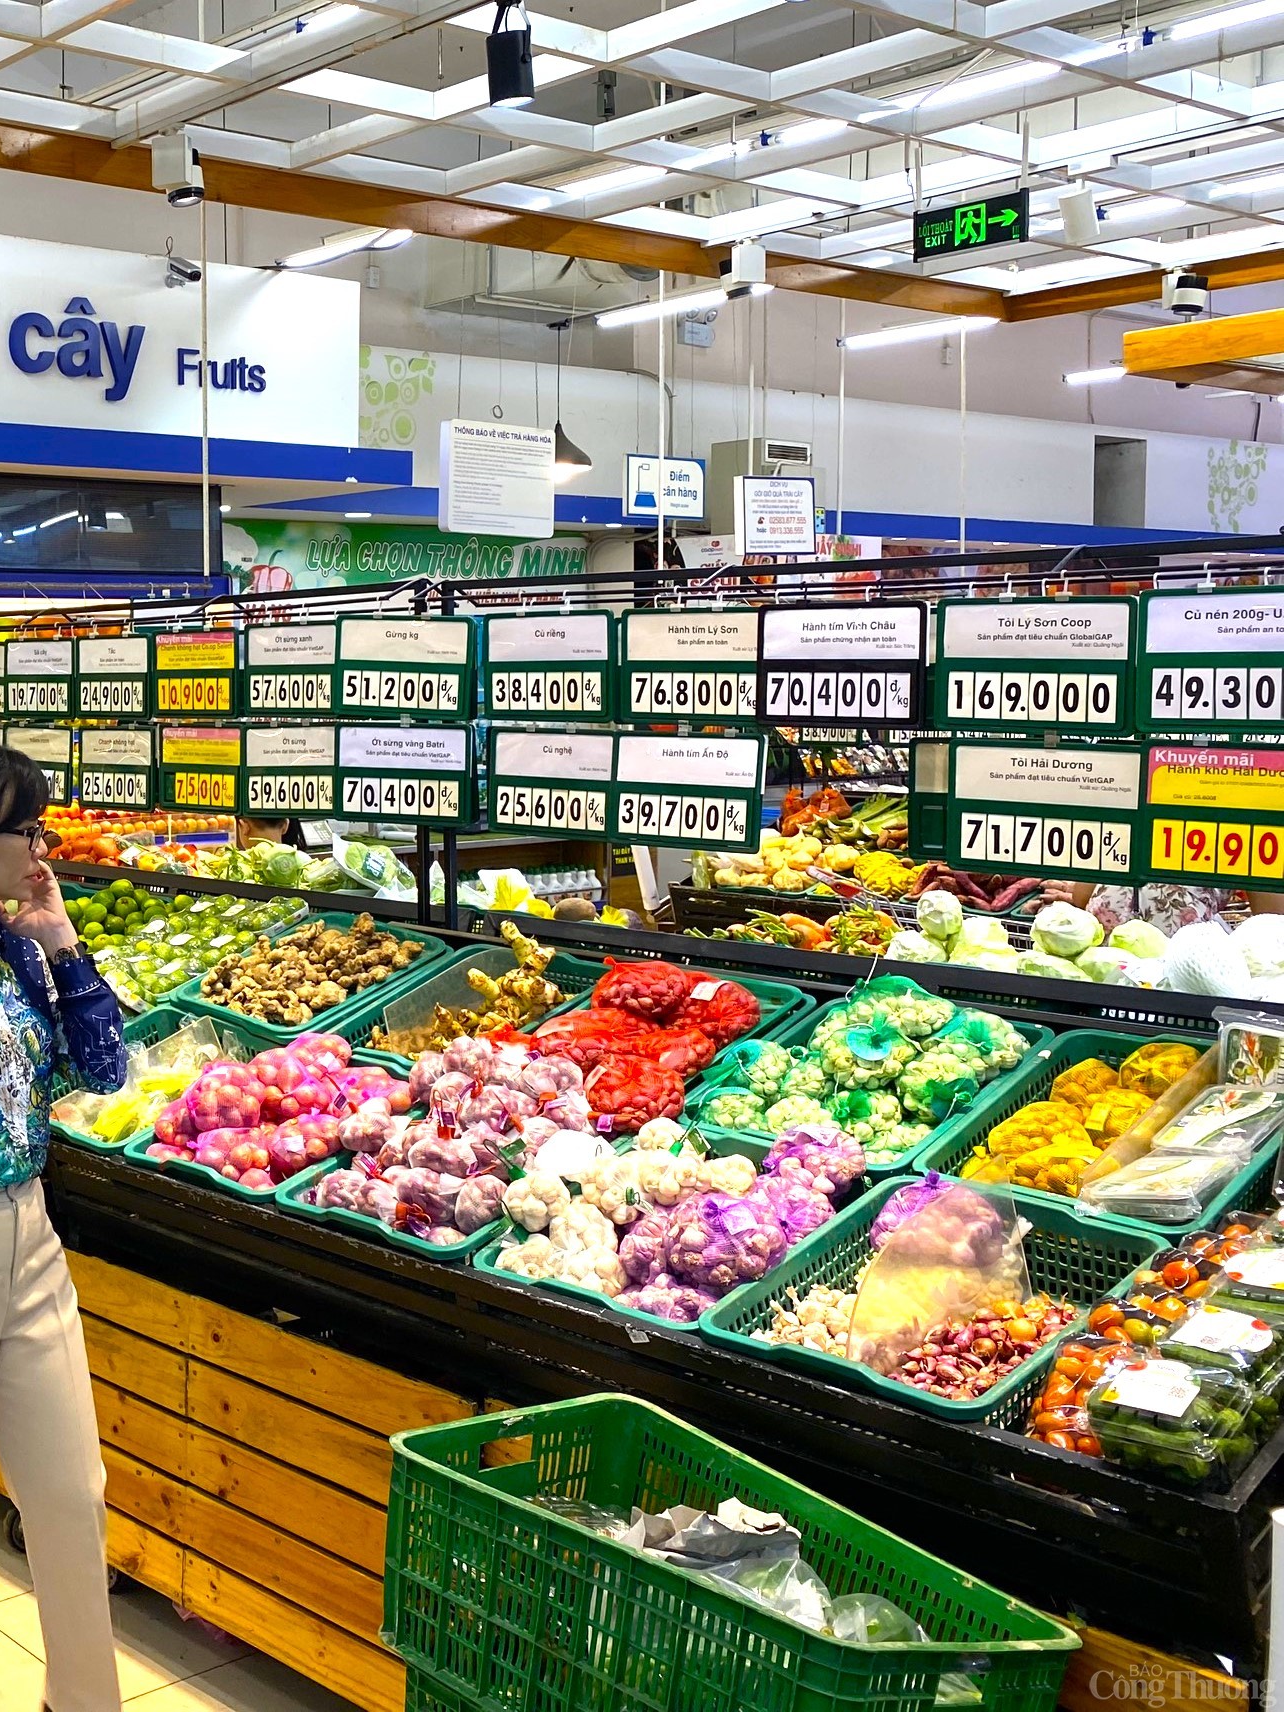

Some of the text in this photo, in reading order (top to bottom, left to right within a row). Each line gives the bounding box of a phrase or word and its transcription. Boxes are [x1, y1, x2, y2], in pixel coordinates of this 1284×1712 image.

[924, 233, 948, 248] EXIT
[9, 297, 146, 402] cây
[670, 469, 690, 482] Điểm
[678, 487, 698, 501] hàng
[306, 534, 588, 579] LỰA CHỌN THÔNG MINH
[1018, 618, 1031, 629] Lý
[1034, 617, 1057, 627] Sơn
[1061, 617, 1092, 629] Coop
[1205, 608, 1229, 620] nén
[385, 630, 419, 642] Gừng kg
[546, 628, 566, 639] riềng
[668, 625, 739, 635] Hành tím Lý Sơn
[802, 622, 826, 631] Hành
[829, 622, 844, 631] tím
[870, 621, 896, 630] Châu
[992, 633, 1013, 642] phẩm
[1015, 633, 1027, 641] đạt
[1028, 633, 1043, 641] tiêu
[1044, 632, 1068, 641] chuẩn
[1069, 633, 1113, 641] GlobalGAP
[12, 685, 57, 706] 19.700
[82, 685, 131, 706] 24.900
[161, 681, 214, 706] 10.900
[252, 679, 330, 703] 57.600 đ/kg
[345, 675, 457, 705] 51.200 đ/kg
[495, 678, 601, 705] 38.400 đ/kg
[635, 678, 757, 709] 76.800 đ/kg
[770, 677, 909, 708] 70.400 đ/kg
[954, 679, 1110, 714] 169.000
[1155, 674, 1276, 709] 49.30
[383, 738, 403, 748] sừng
[405, 739, 424, 748] vàng
[426, 739, 445, 748] Batri
[554, 746, 573, 756] nghệ
[662, 747, 729, 761] Hành tím Ấn Độ
[1155, 749, 1254, 767] Khuyến mãi
[1052, 759, 1093, 772] Dương
[1167, 764, 1201, 775] Hành
[84, 776, 134, 798] 25.600
[1005, 772, 1026, 781] phẩm
[1027, 773, 1039, 781] đạt
[1041, 774, 1055, 782] tiêu
[1057, 774, 1080, 783] chuẩn
[1082, 776, 1115, 784] VietGAP
[250, 781, 332, 804] 59.600 đ/kg
[347, 780, 458, 811] 70.400 đ/kg
[499, 792, 604, 825] 25.600 đ/kg
[621, 798, 745, 835] 39.700 đ/kg
[966, 819, 1127, 866] 71.700 đ/kg
[1163, 827, 1279, 866] 19.90
